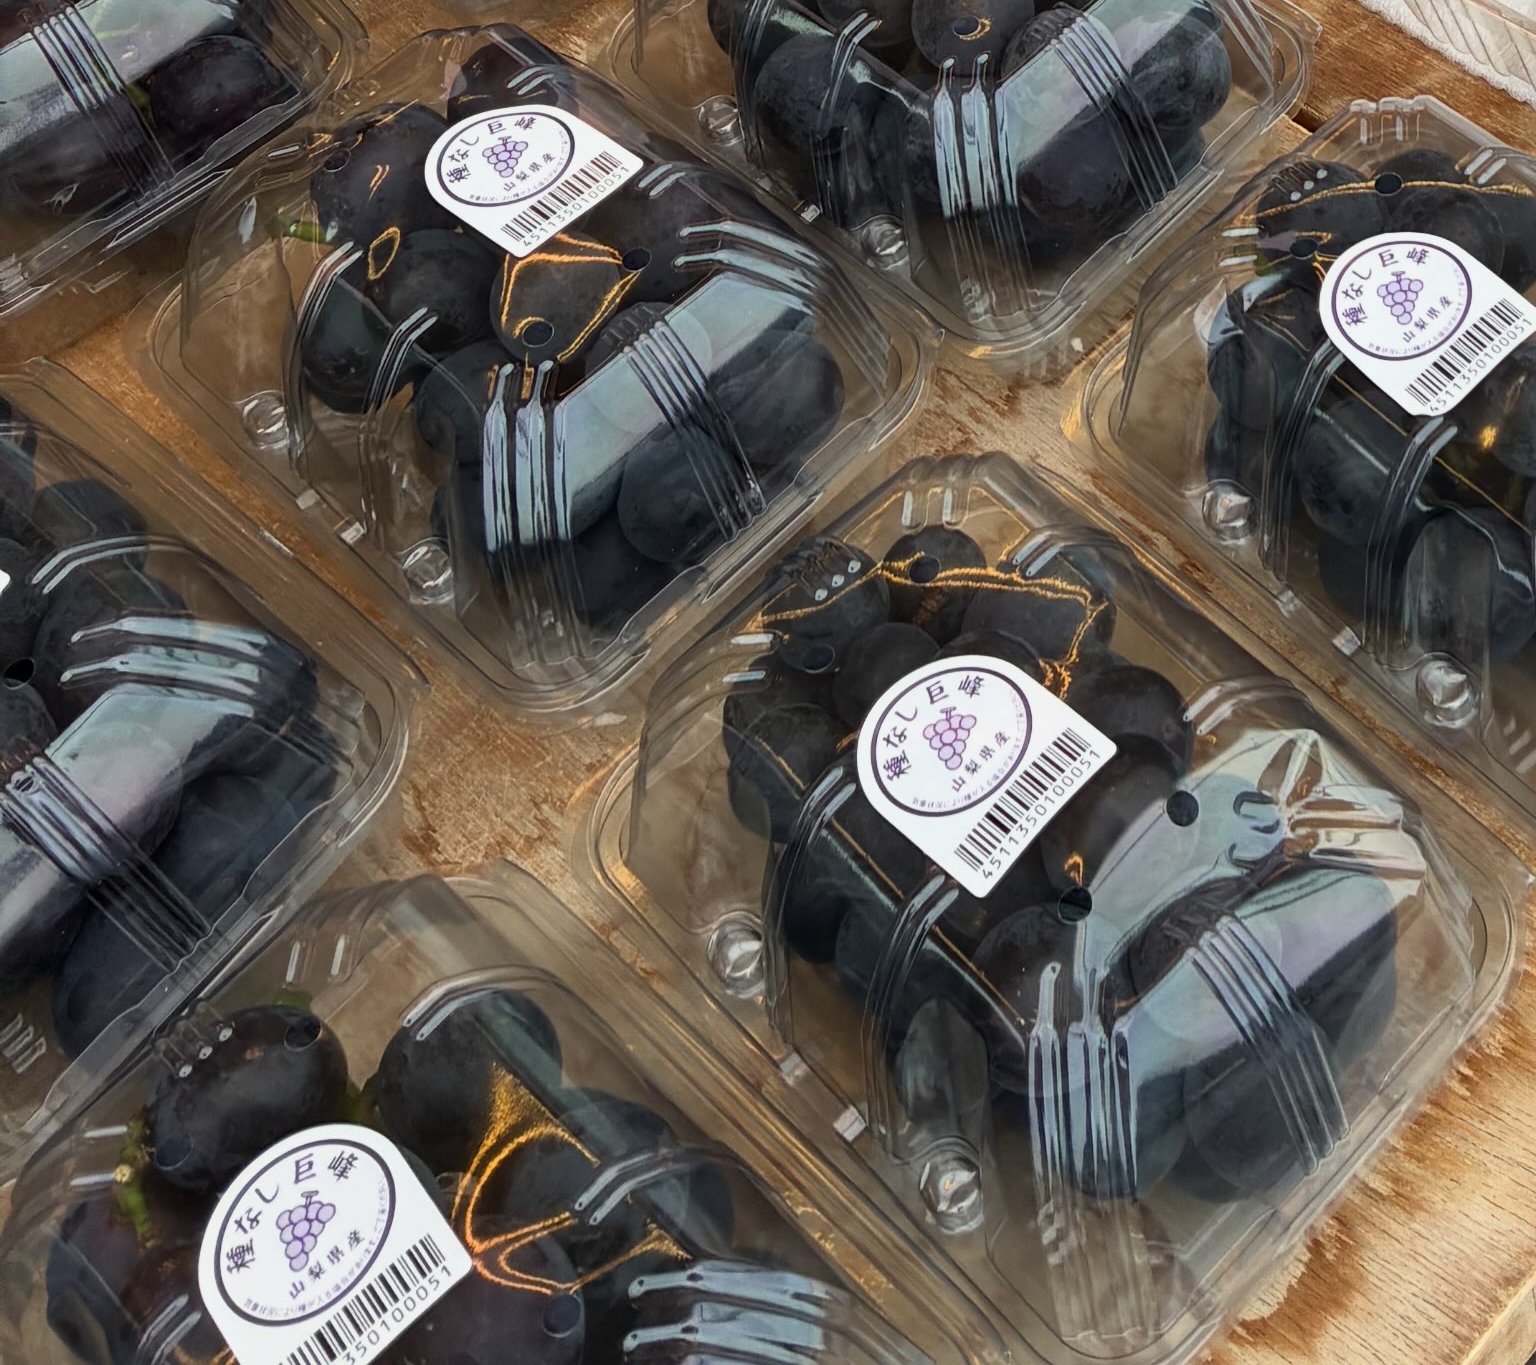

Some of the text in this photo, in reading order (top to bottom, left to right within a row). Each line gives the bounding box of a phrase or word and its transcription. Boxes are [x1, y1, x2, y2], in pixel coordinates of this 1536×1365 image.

[448, 116, 537, 185] 種なし巨峰
[502, 152, 557, 193] 山梨県産
[522, 166, 631, 248] 4511350100051
[1341, 246, 1430, 327] 種なし巨峰
[1401, 294, 1454, 344] 山梨県産
[1429, 317, 1534, 412] 4511350100051
[882, 674, 985, 782] 種なし巨峰
[951, 729, 1012, 794] 山梨県産
[981, 748, 1102, 881] 4511350100051
[225, 1150, 360, 1275] 種なし巨峰
[287, 1228, 366, 1300] 山梨県産
